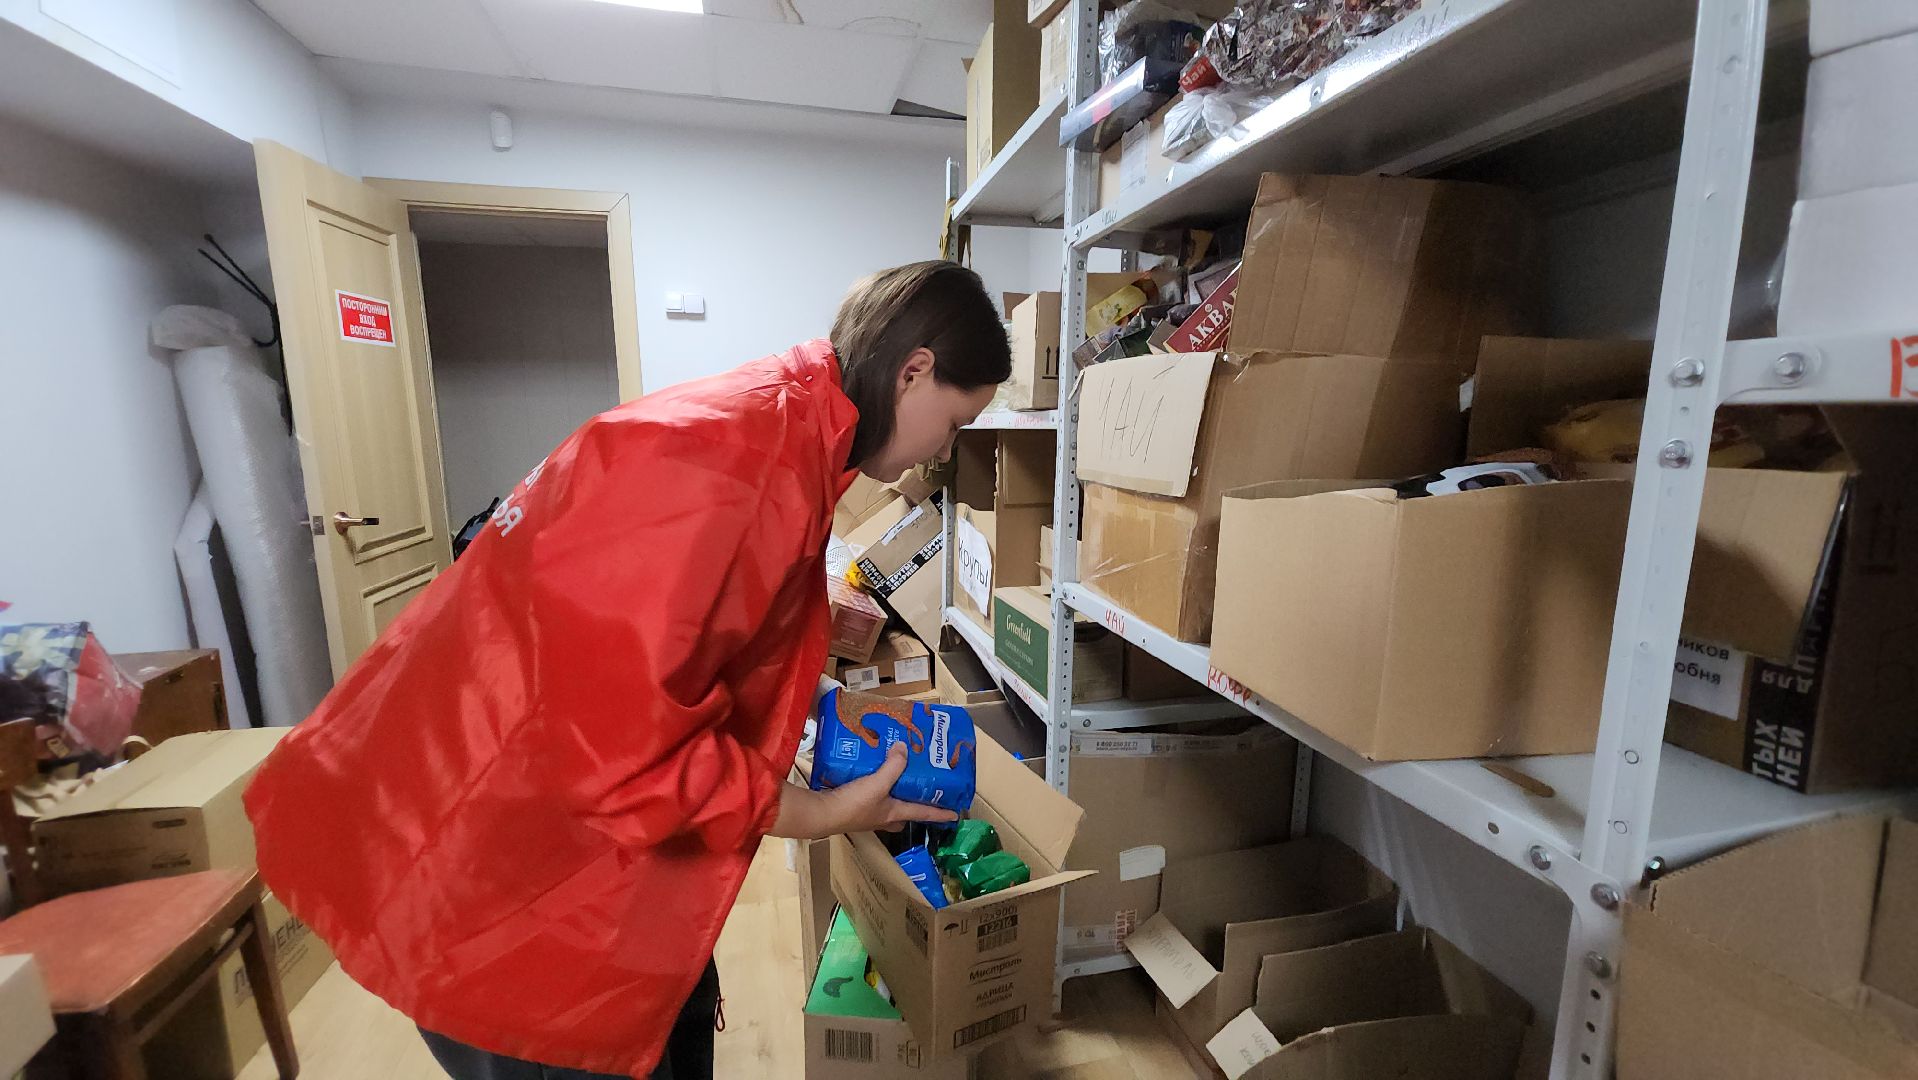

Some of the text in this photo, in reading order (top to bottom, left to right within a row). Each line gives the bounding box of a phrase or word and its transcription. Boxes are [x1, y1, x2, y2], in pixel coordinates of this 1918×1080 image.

[341, 297, 388, 317] ПОСТОРОННИМ
[358, 313, 376, 328] ВХОД
[350, 324, 387, 340] ВОСПРЕЩЕН
[1678, 637, 1729, 661] иков
[1674, 662, 1721, 685] обня
[935, 713, 947, 764] Мистраль
